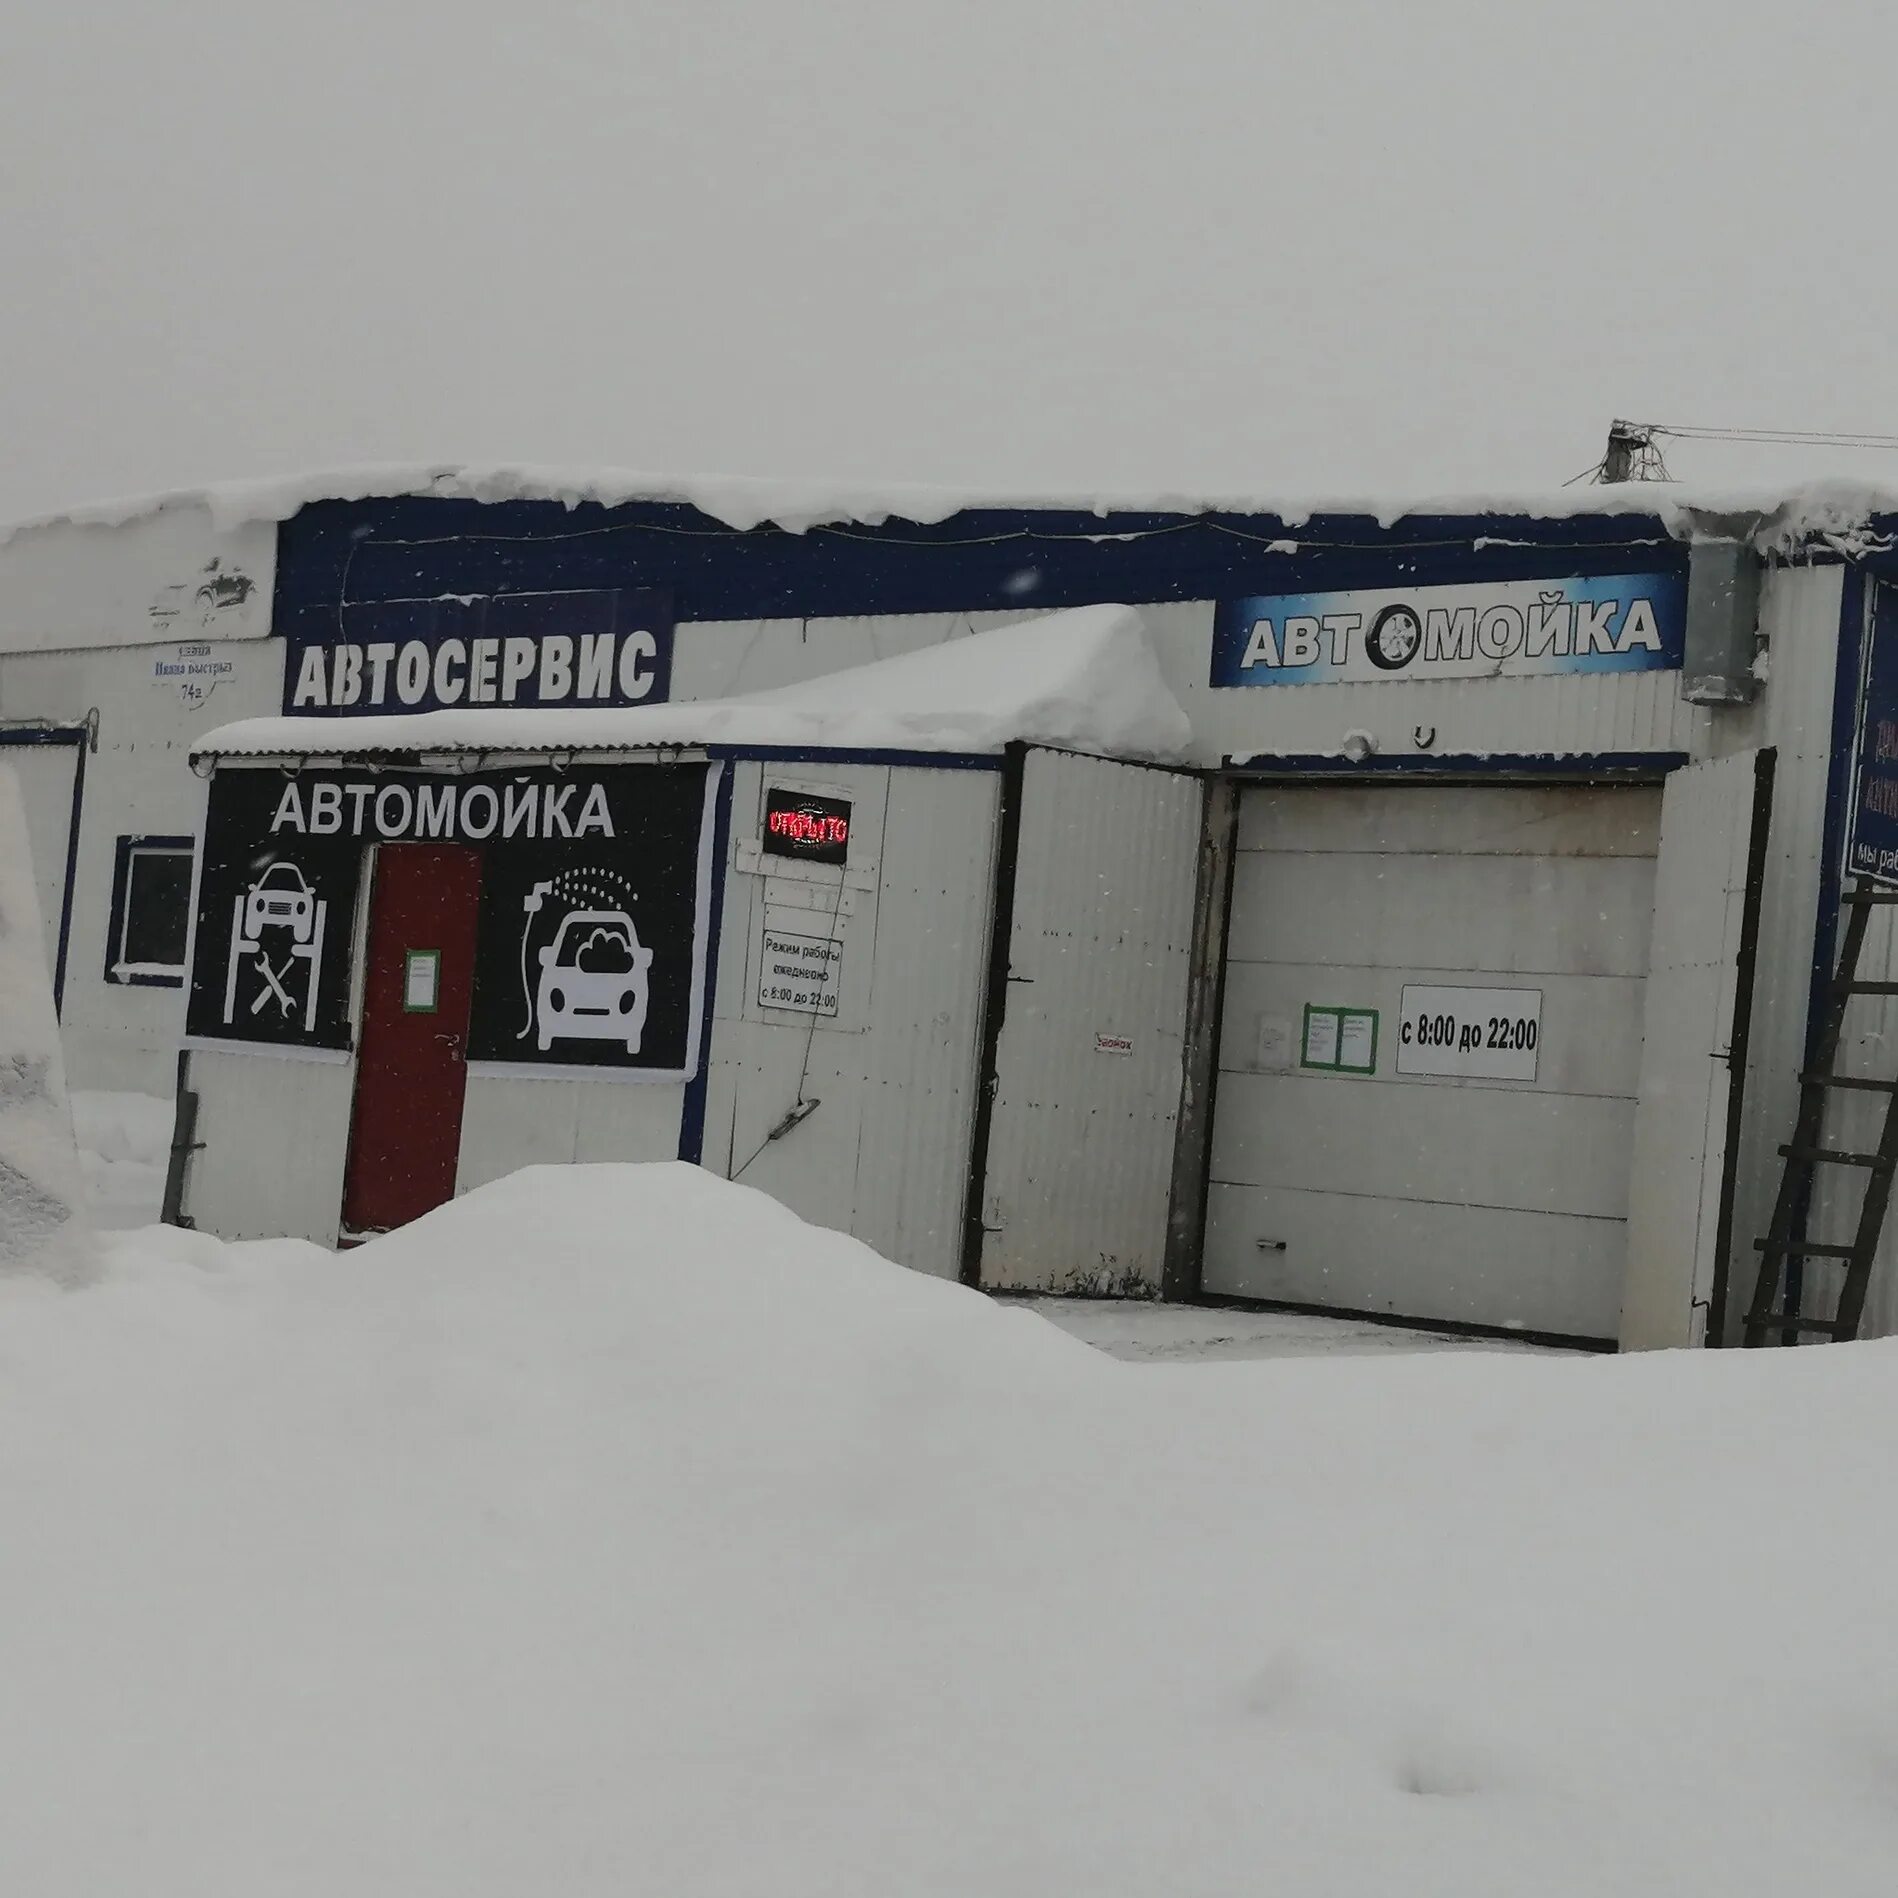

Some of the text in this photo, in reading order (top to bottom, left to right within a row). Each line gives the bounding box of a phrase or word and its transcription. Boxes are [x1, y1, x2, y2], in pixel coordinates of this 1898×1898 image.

[1239, 591, 1663, 670] АВТОМОЙКА
[292, 629, 657, 708] АВТОСЕРВИС
[269, 777, 617, 840] АВТОМОЙКА
[769, 812, 847, 843] ОТКРЫТО
[766, 938, 840, 962] Режим работы
[771, 986, 792, 1001] 8:00
[794, 994, 808, 1005] до
[810, 992, 836, 1008] 22:00
[1417, 1013, 1455, 1046] 8:00
[1458, 1023, 1482, 1052] до
[1486, 1016, 1538, 1050] 22:00
